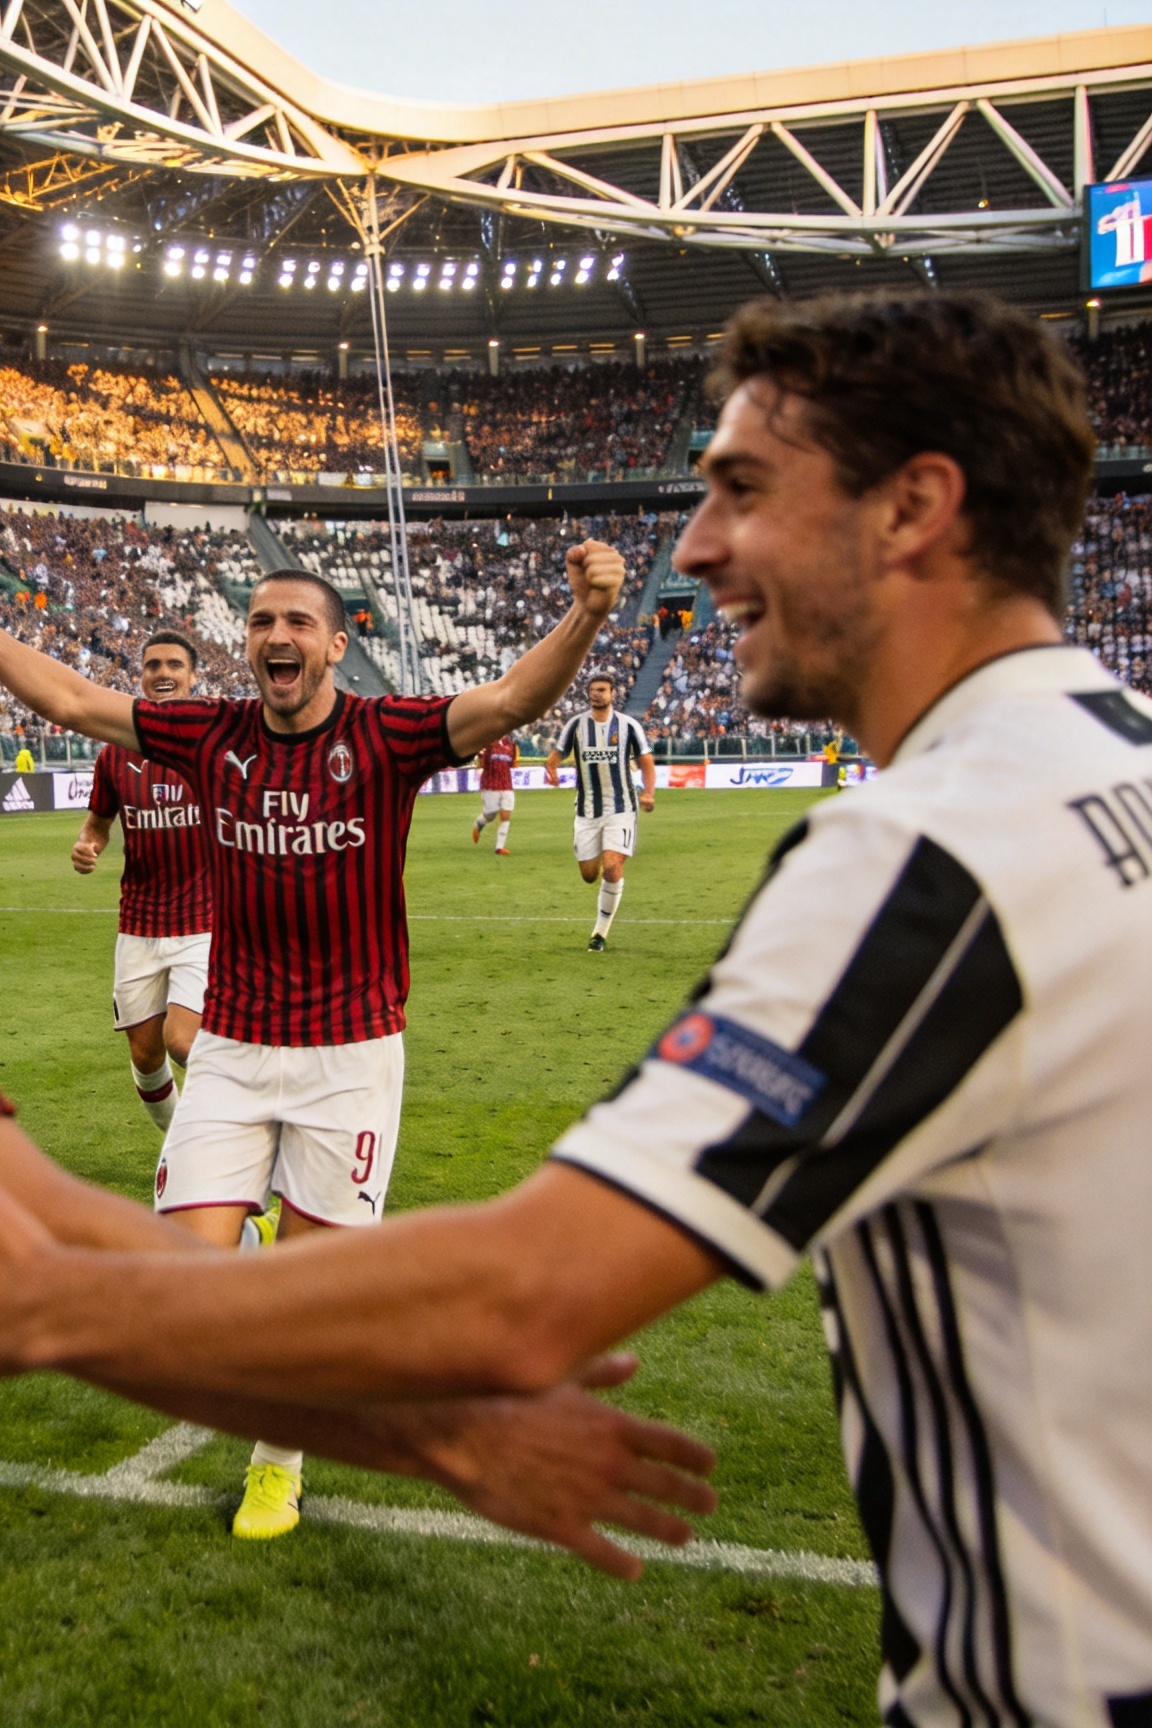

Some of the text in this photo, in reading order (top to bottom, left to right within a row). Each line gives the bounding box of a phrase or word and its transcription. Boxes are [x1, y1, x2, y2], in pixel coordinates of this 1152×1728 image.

[262, 790, 309, 822] Fly
[215, 807, 366, 856] Emirates
[351, 1130, 376, 1185] 9
